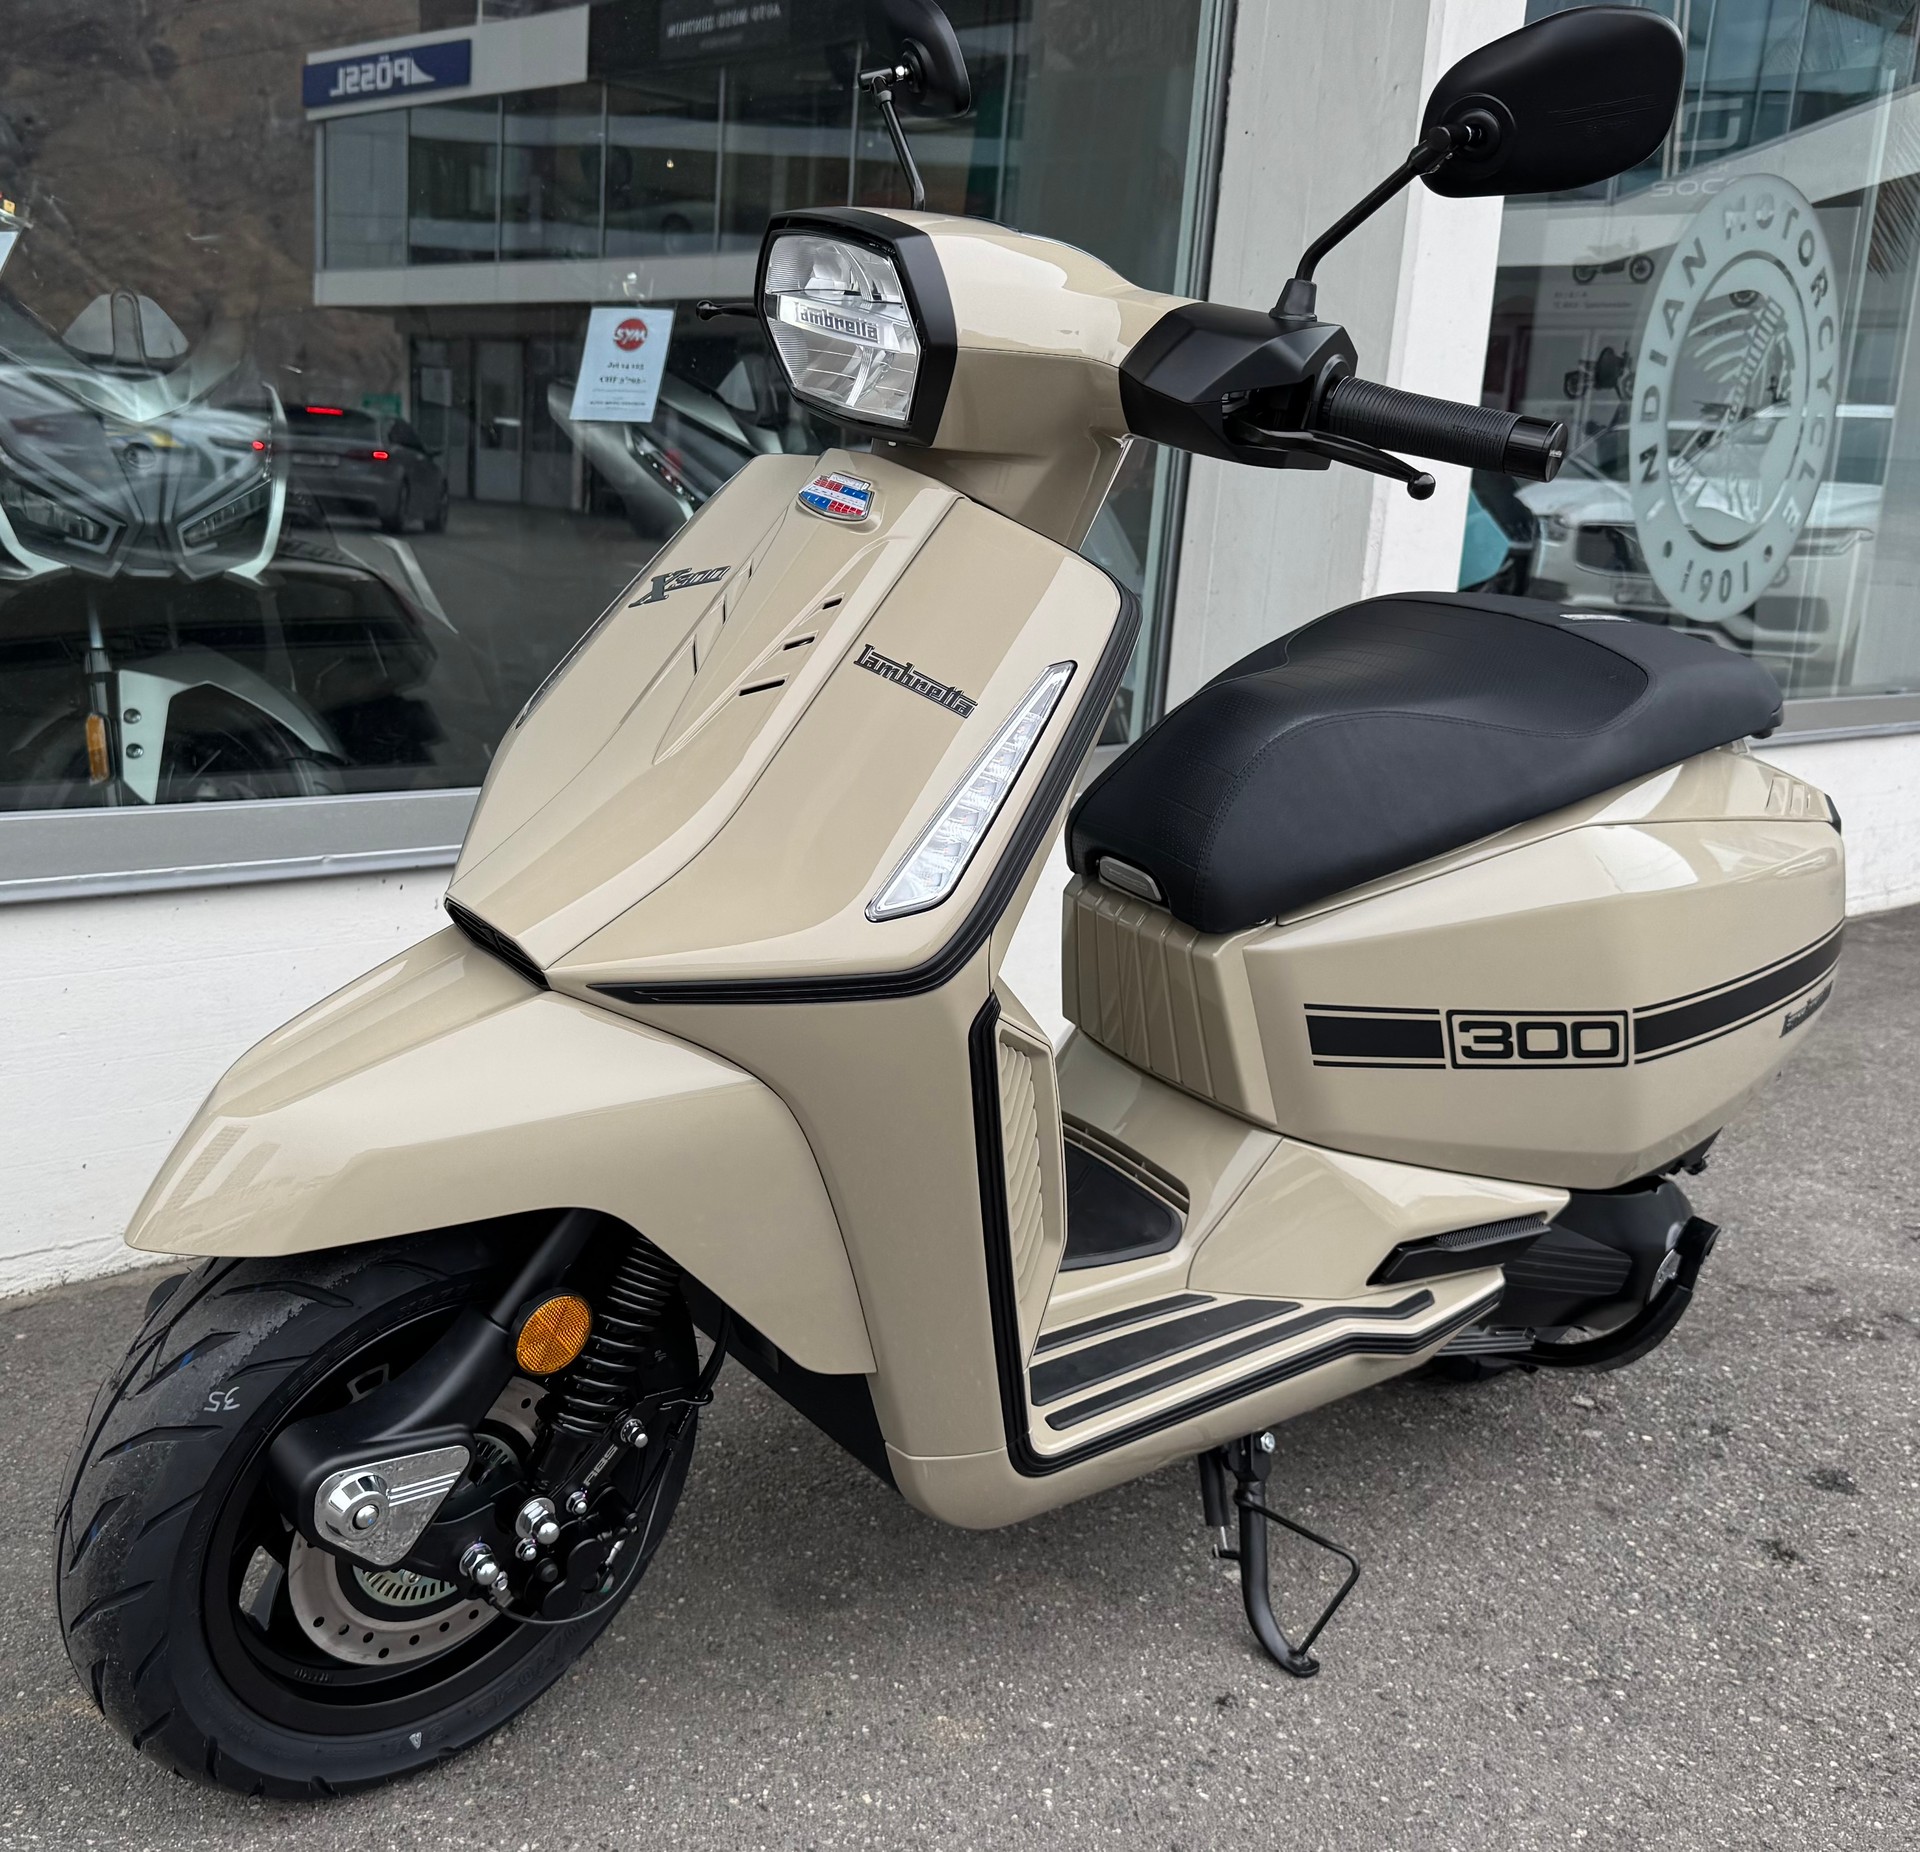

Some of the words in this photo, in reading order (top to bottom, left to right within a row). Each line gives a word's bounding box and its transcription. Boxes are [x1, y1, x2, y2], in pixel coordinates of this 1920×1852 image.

[613, 327, 648, 345] SYM
[1639, 237, 1707, 522] INDIAN
[1722, 192, 1835, 530] MOTORCYCLE
[1678, 559, 1751, 604] 1901
[1458, 1020, 1620, 1060] 300
[583, 1443, 619, 1487] ABS
